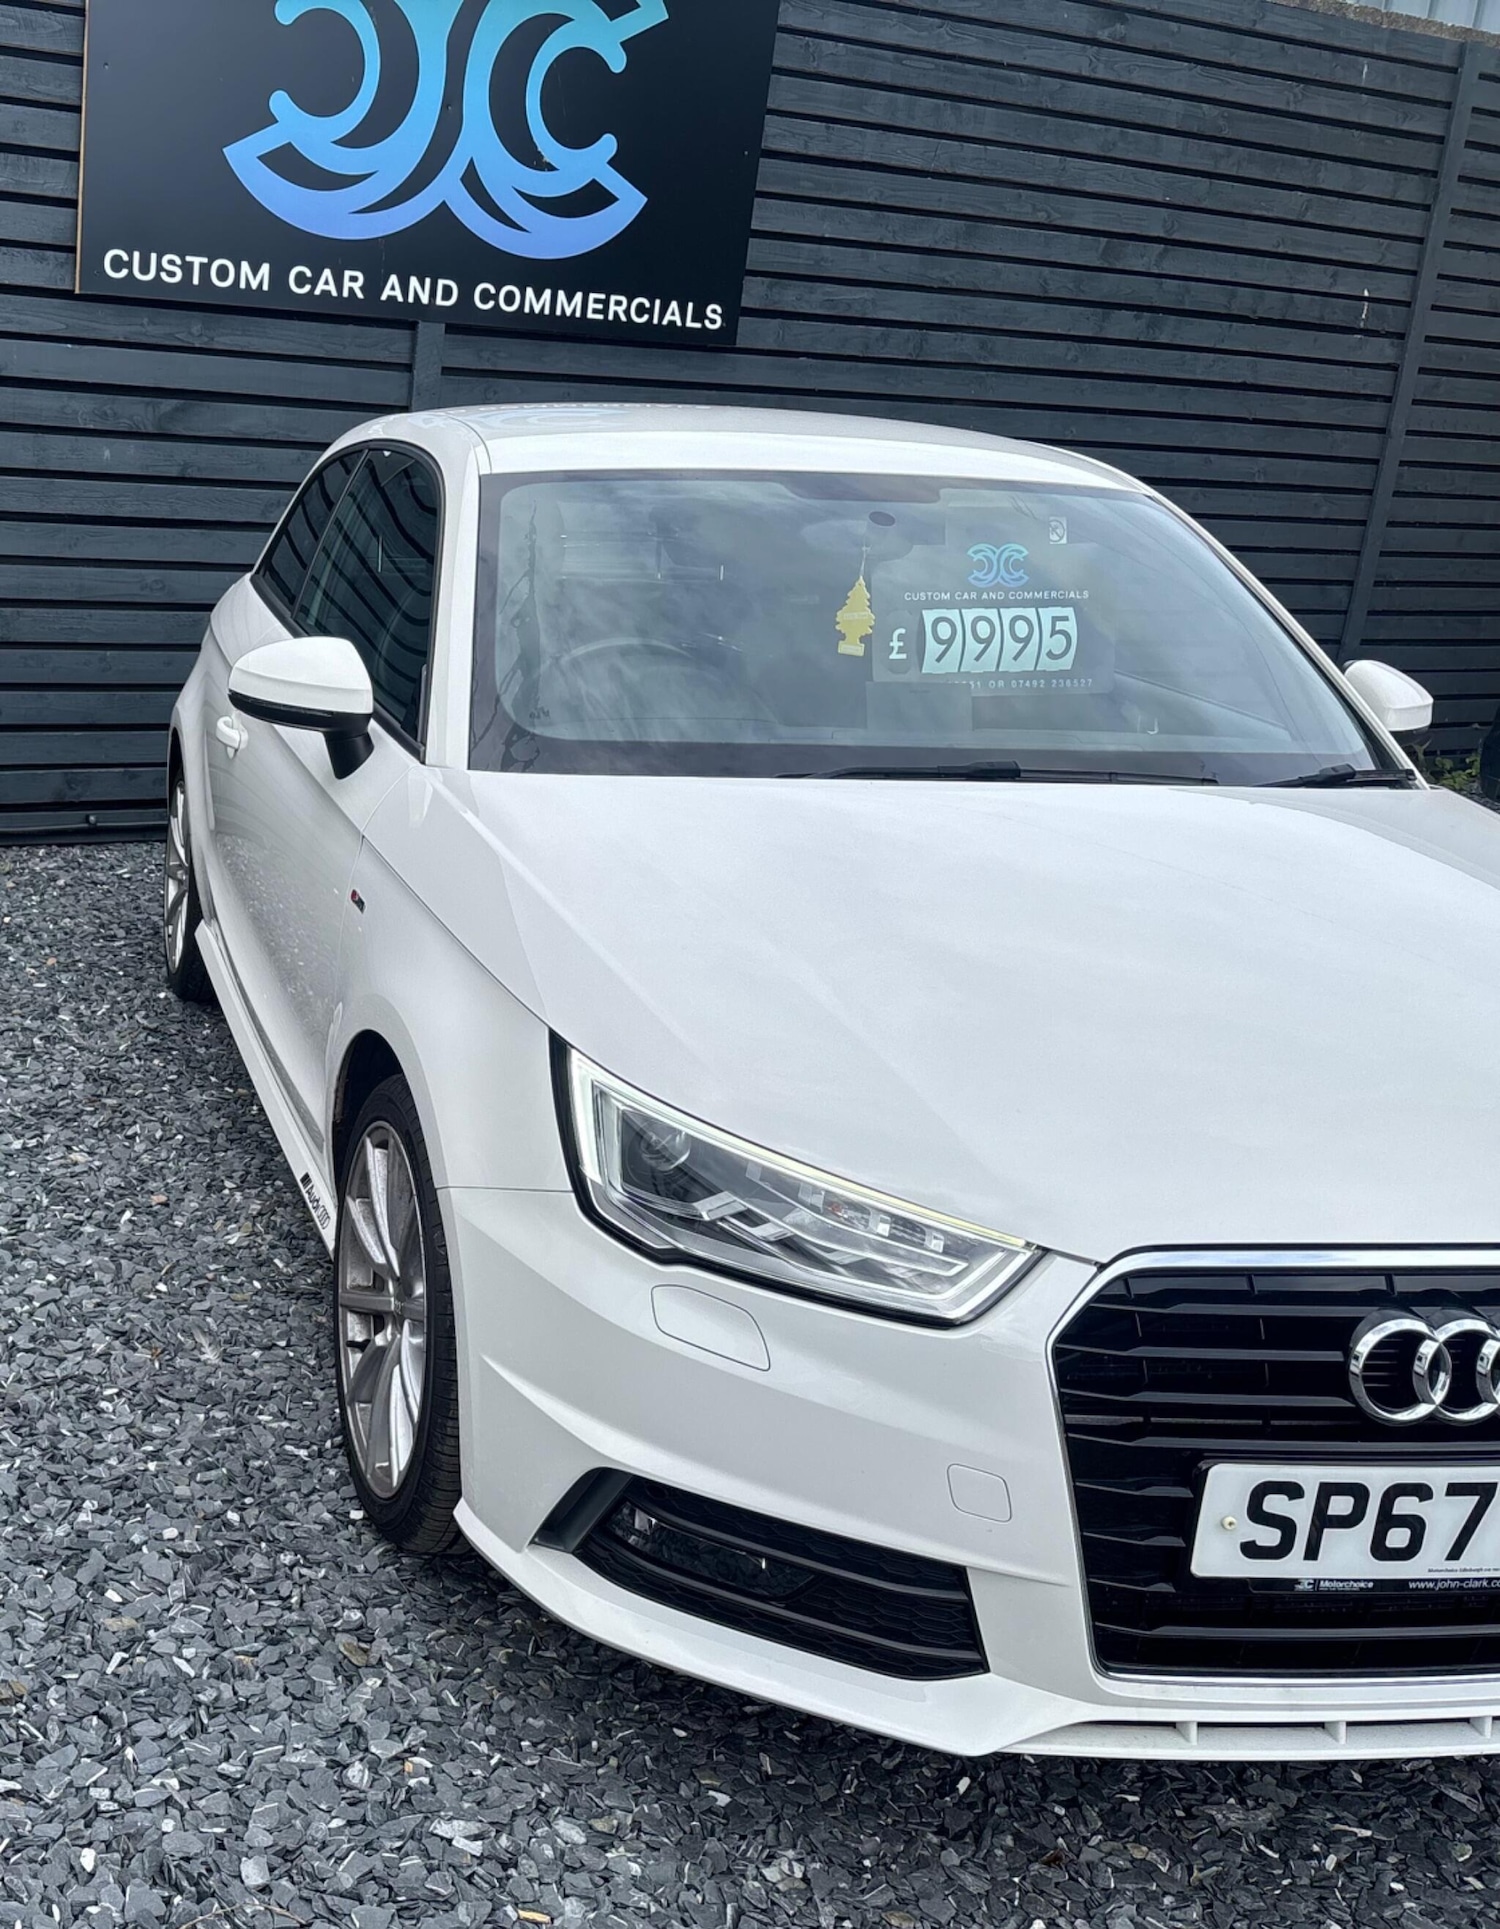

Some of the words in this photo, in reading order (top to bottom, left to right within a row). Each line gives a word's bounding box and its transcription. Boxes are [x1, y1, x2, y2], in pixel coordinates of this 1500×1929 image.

[103, 248, 271, 291] CUSTOM
[288, 265, 365, 299] CAR
[380, 274, 459, 307] AND
[473, 282, 723, 331] COMMERCIALS
[904, 591, 951, 601] CUSTOM
[955, 591, 977, 600] CAR
[981, 591, 1005, 600] AND
[1008, 590, 1090, 600] COMMERCIALS
[931, 615, 1073, 664] 9995
[988, 679, 1005, 689] OR
[1011, 679, 1045, 688] 07492
[1239, 1480, 1499, 1563] SP67
[1319, 1580, 1374, 1589] Motorchoice
